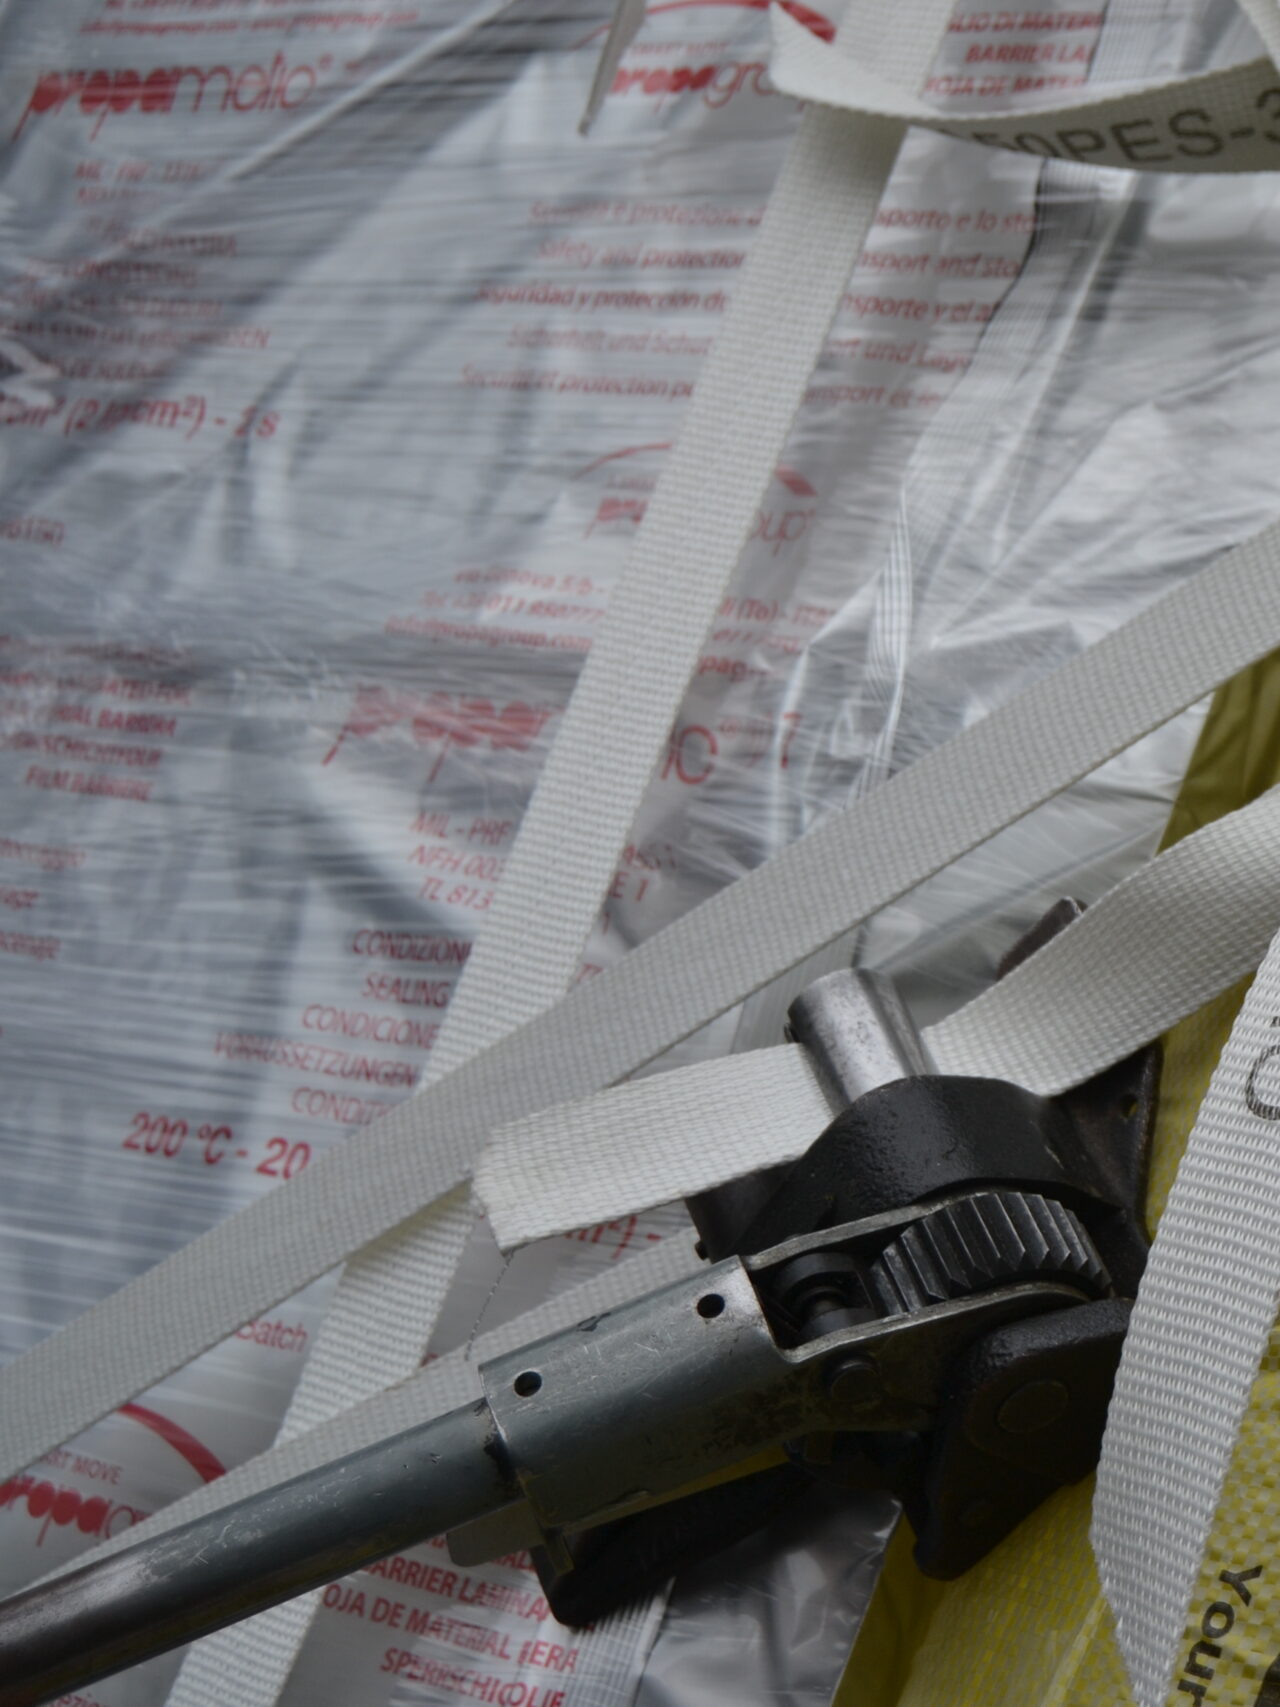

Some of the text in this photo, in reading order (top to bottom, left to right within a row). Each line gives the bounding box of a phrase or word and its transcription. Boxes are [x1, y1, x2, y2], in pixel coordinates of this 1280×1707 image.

[121, 1111, 189, 1159] 200
[370, 1597, 406, 1629] DE
[405, 1608, 512, 1661] MATERIAL
